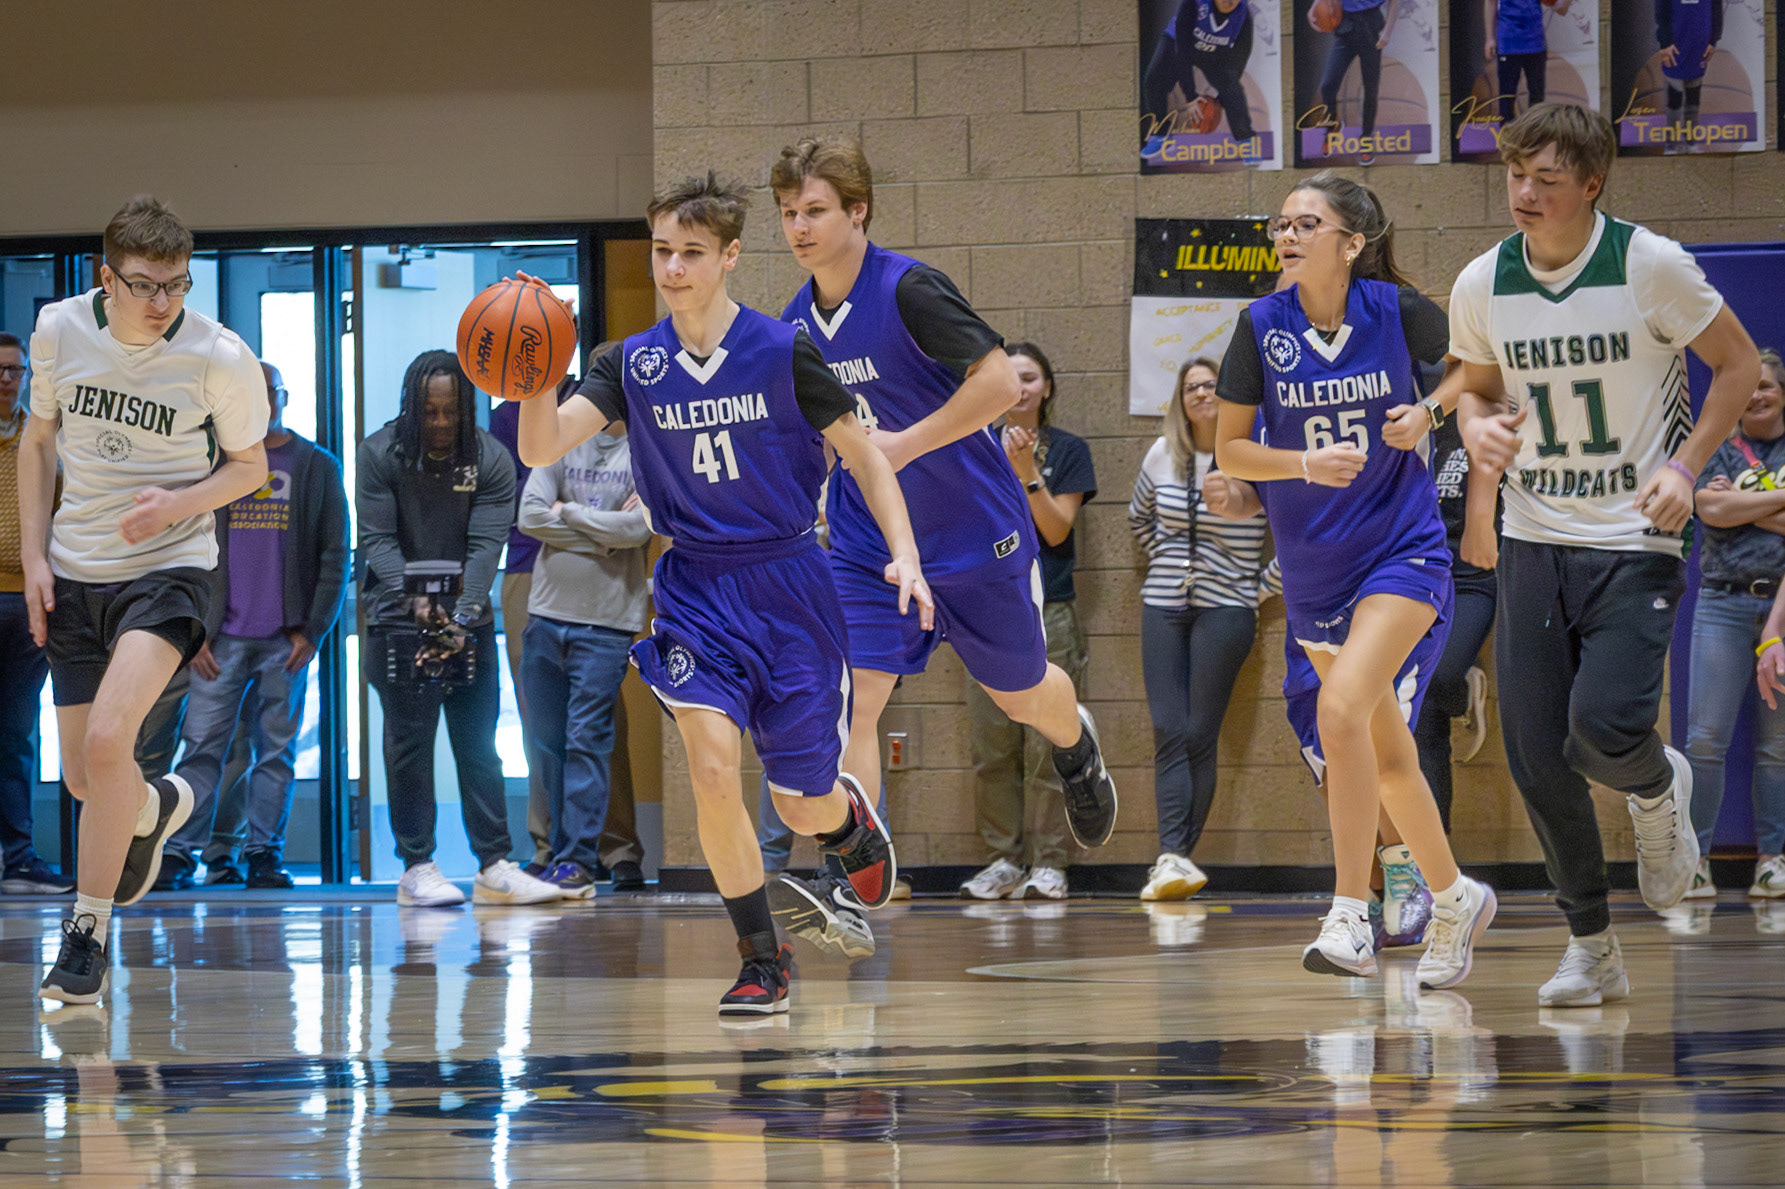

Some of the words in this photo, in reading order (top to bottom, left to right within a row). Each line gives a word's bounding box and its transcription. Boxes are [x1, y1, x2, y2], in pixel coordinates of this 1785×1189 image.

[1161, 136, 1262, 165] Campbell
[1327, 130, 1411, 154] Rosted
[1633, 120, 1748, 145] TenHopen
[514, 325, 543, 395] Rawlings
[630, 346, 649, 362] SPECIAL
[827, 356, 880, 385] DONIA
[650, 364, 669, 386] SPORTS
[1276, 370, 1392, 408] CALEDONIA
[69, 385, 177, 437] JENISON
[652, 392, 769, 430] CALEDONIA
[855, 393, 879, 430] 4
[1526, 377, 1622, 459] 11
[1304, 409, 1369, 456] 65
[564, 465, 628, 485] ALEDONI
[692, 430, 740, 484] 41
[1519, 462, 1638, 499] WILDCATS
[230, 512, 289, 521] DUCATION
